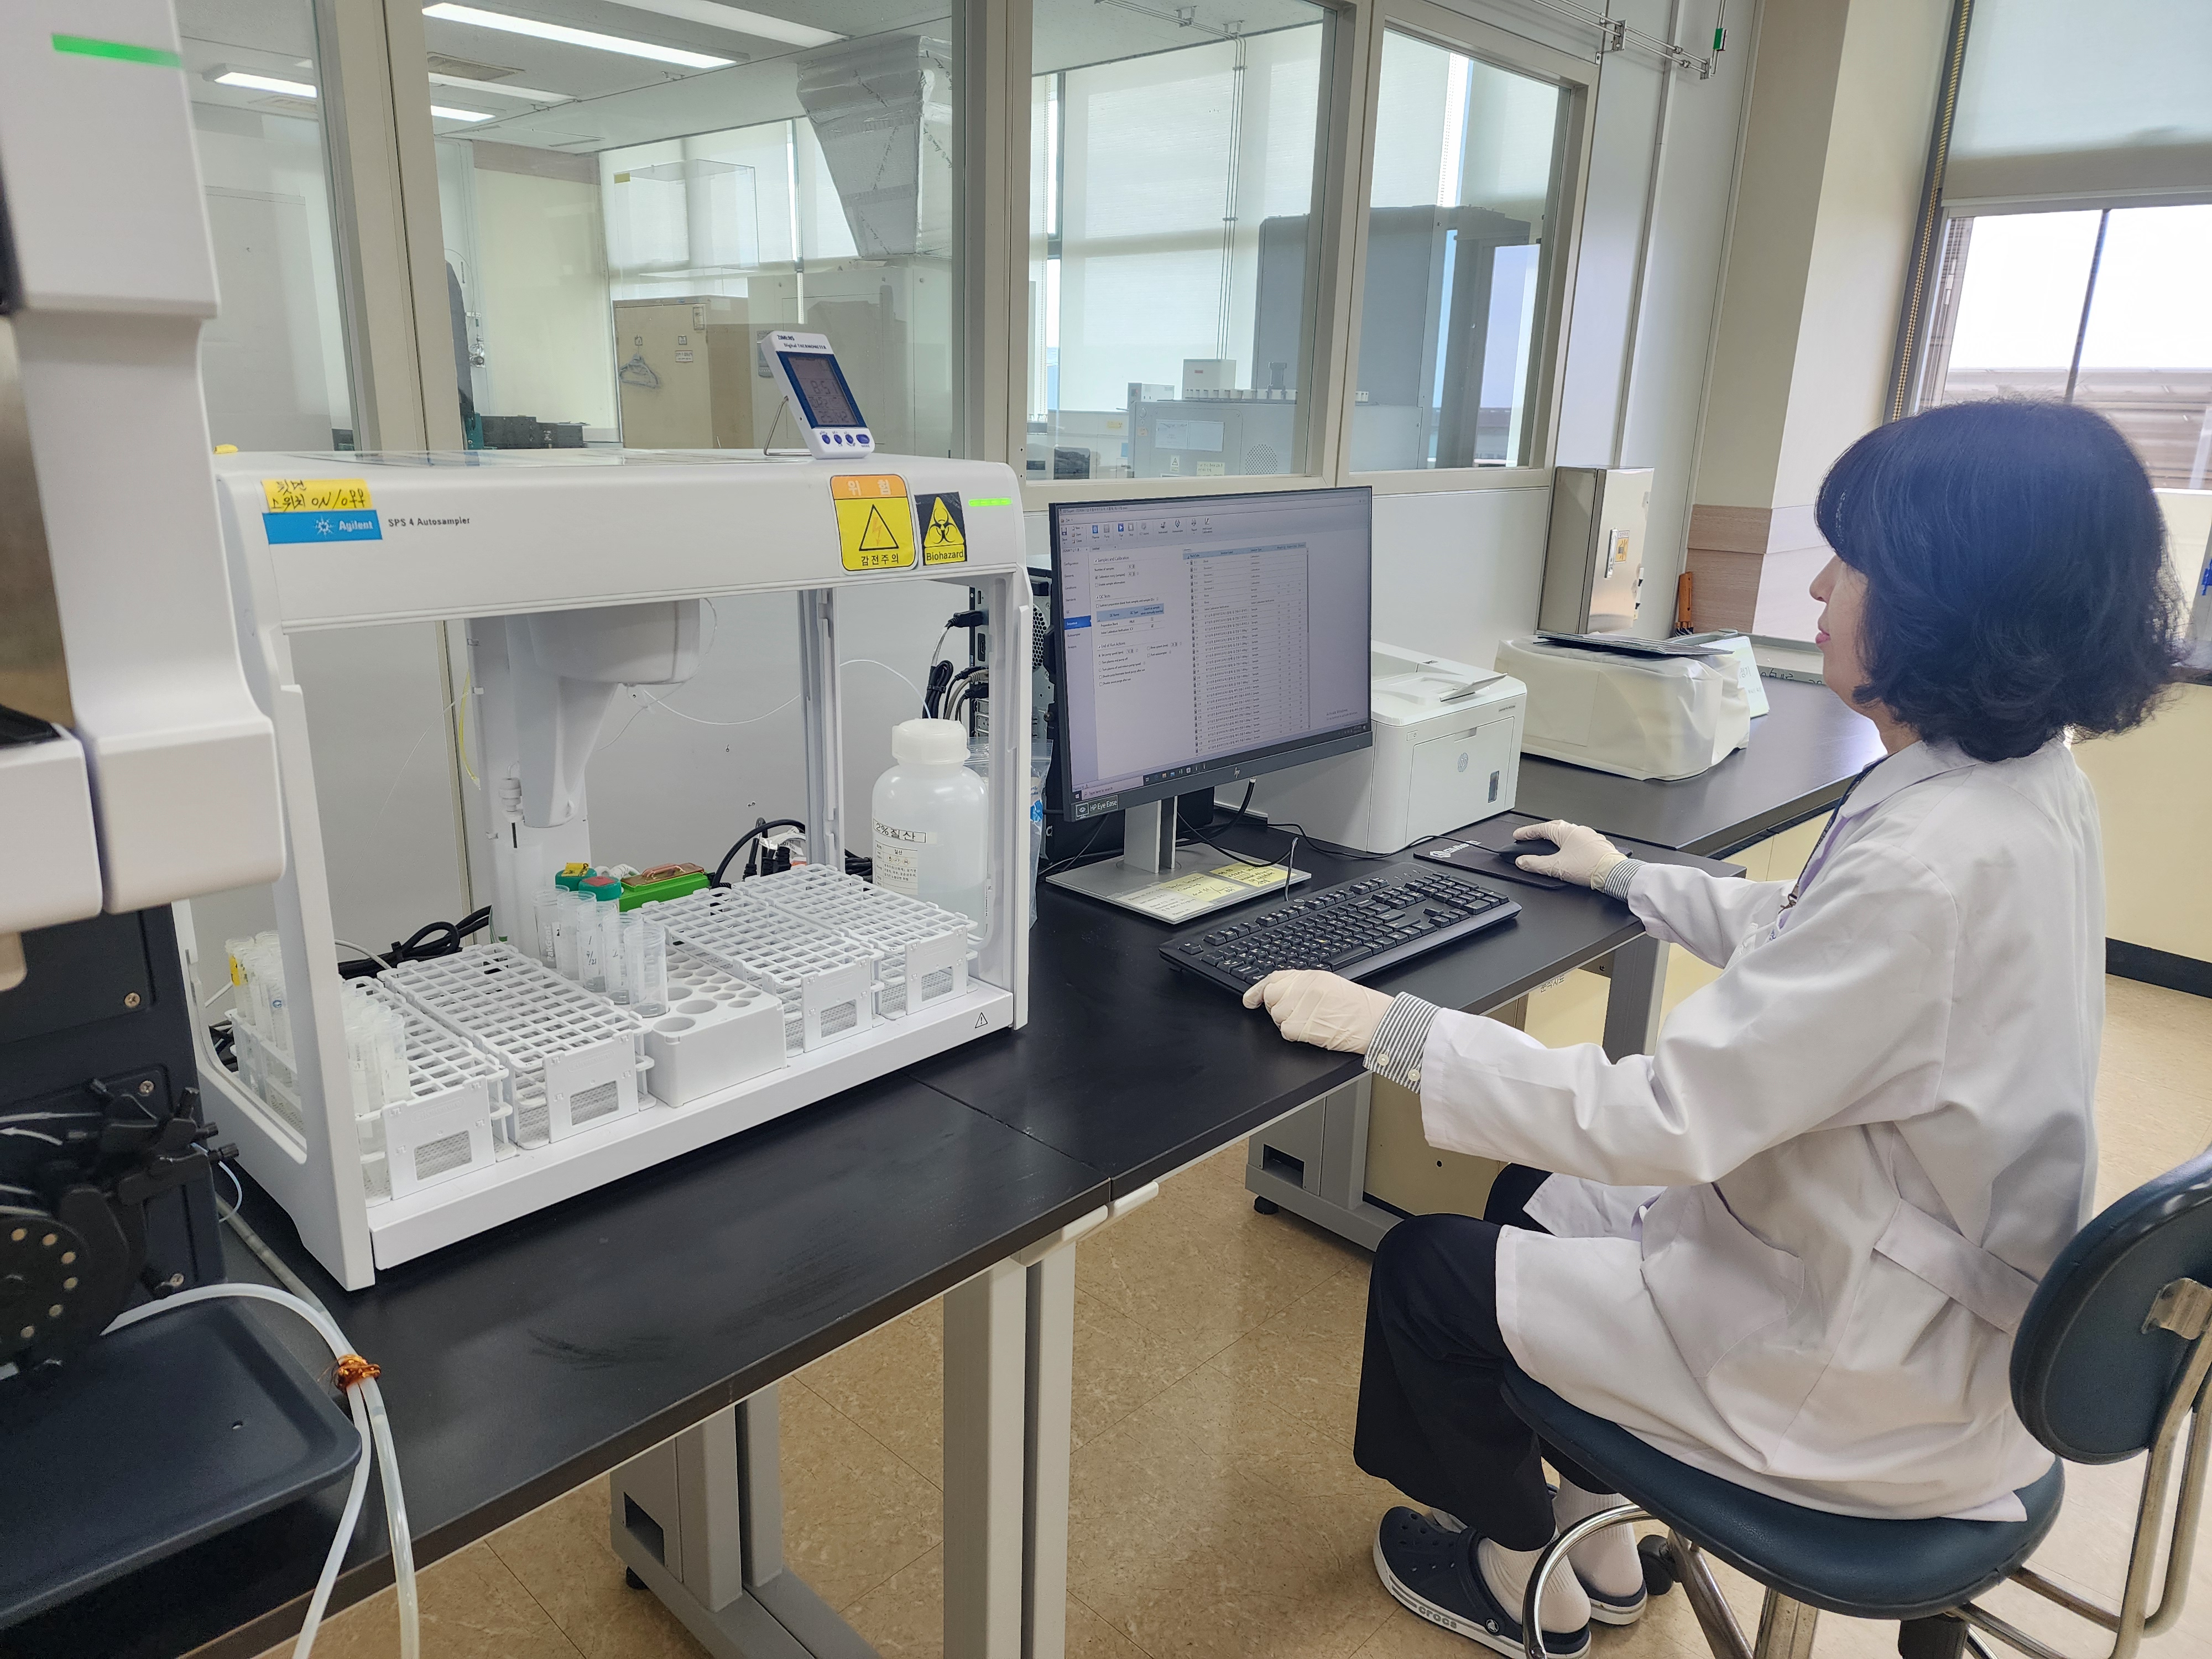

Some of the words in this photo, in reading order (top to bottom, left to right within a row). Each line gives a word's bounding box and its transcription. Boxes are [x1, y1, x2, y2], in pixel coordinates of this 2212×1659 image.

[847, 480, 862, 496] 위
[877, 479, 891, 495] 험
[339, 520, 373, 533] Agilent
[388, 519, 406, 527] SPS
[416, 517, 470, 526] Autosampler
[861, 553, 899, 566] 감전주의
[926, 549, 964, 561] Biohazard
[1458, 753, 1468, 773] hp
[1090, 804, 1097, 812] HP
[1418, 1606, 1457, 1629] crocs
